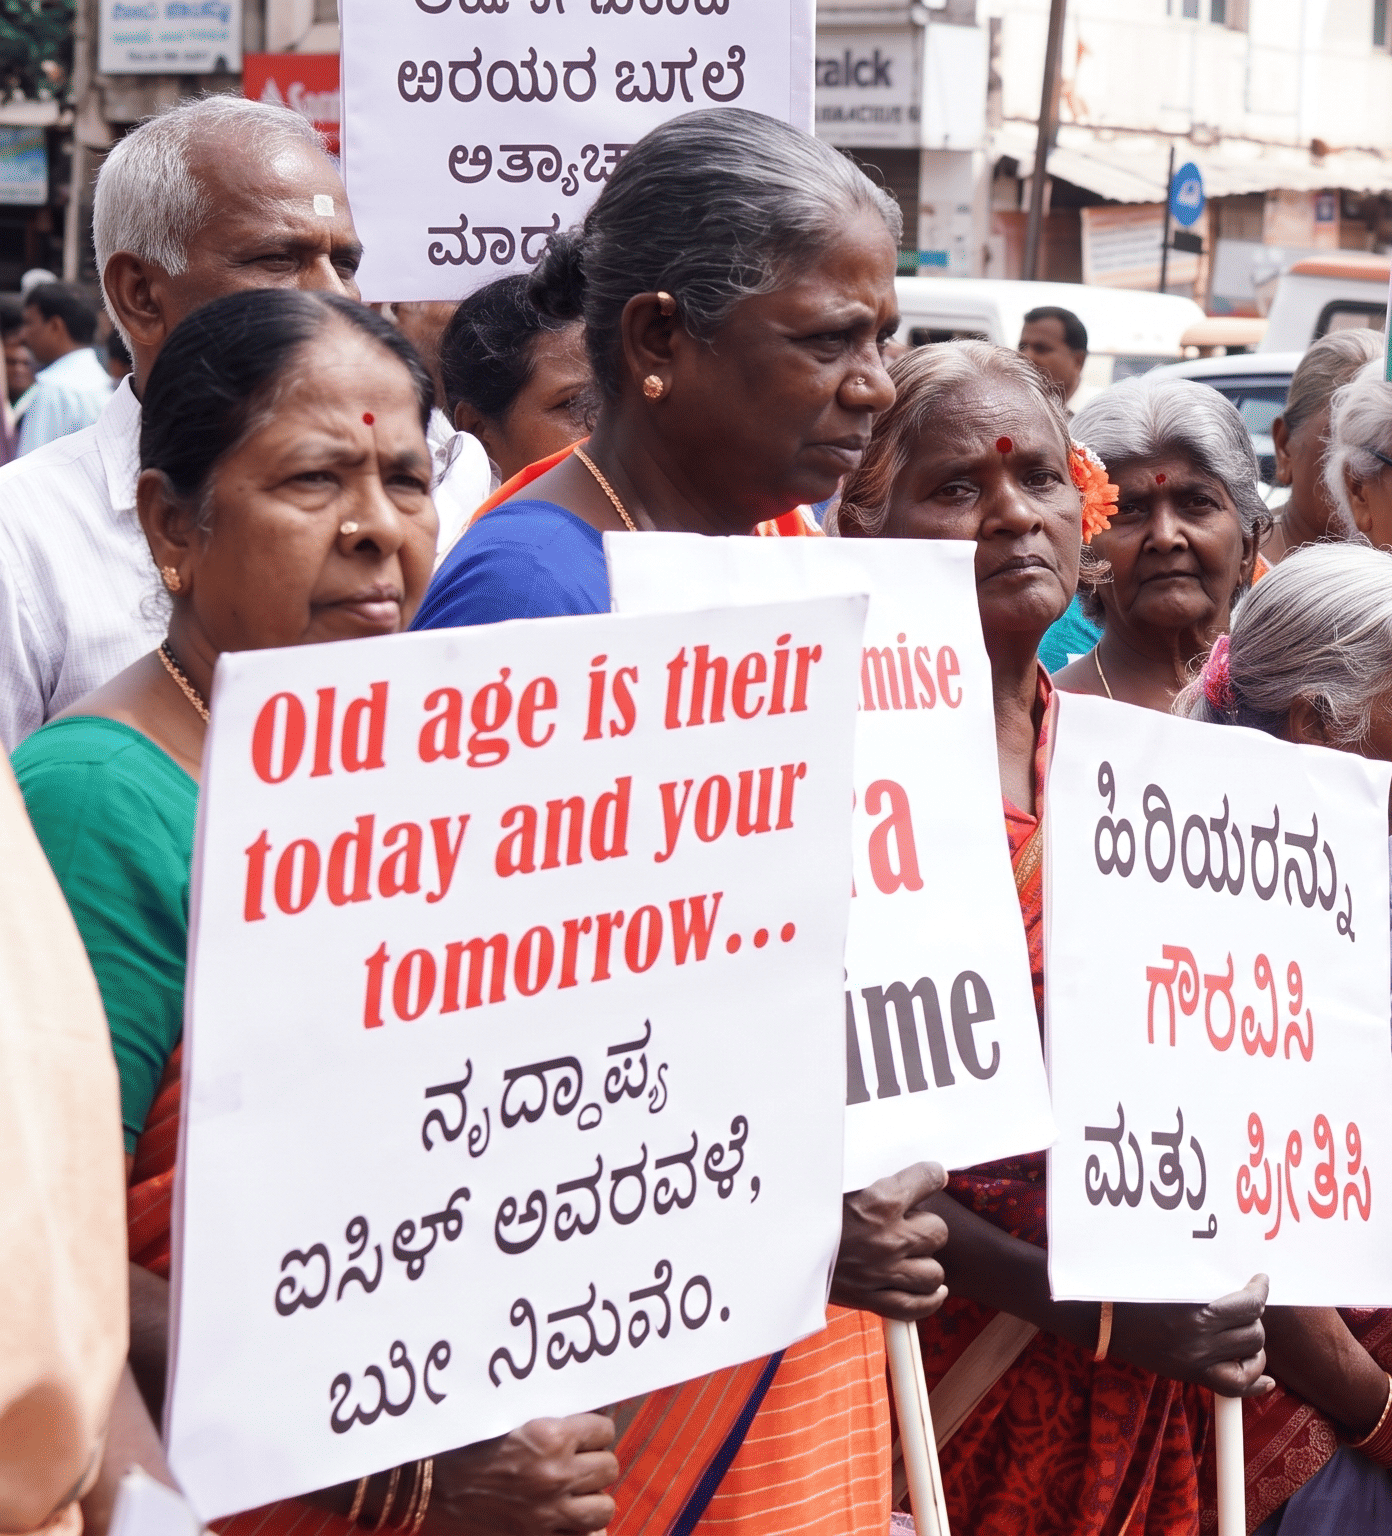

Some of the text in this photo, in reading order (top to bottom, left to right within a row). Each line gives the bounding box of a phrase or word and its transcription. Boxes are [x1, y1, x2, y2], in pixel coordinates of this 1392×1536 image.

[252, 634, 822, 784] Old age is their
[858, 632, 963, 711] mise
[244, 762, 807, 922] today and your
[851, 779, 925, 899] a
[1095, 761, 1355, 942] ಹಿರಿಯರನ್ನು
[364, 896, 795, 1029] tomorrow...
[1146, 945, 1313, 1062] ಗೌರವಿಸಿ
[1085, 1102, 1371, 1240] ಮತ್ತು ಪ್ರೀತಿಸಿ
